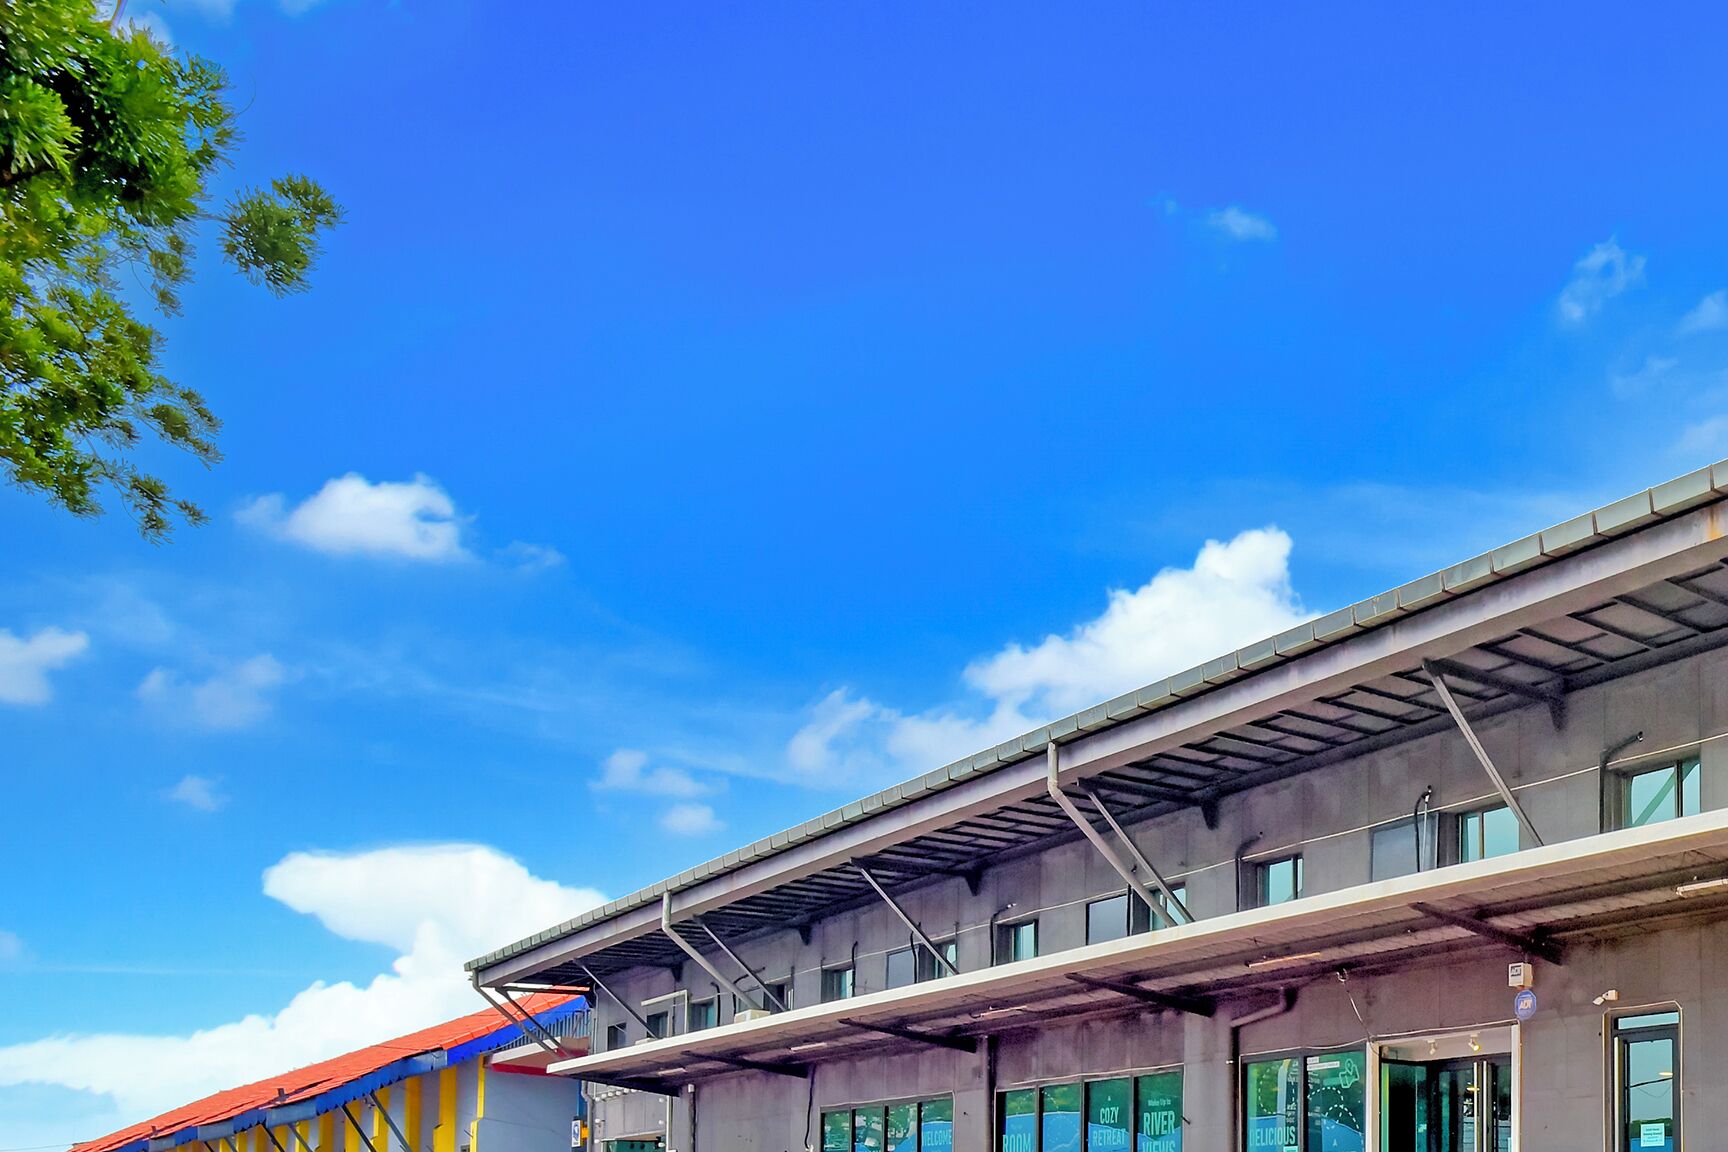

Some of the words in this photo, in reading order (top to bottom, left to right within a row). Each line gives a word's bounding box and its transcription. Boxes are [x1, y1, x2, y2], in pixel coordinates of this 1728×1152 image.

[1100, 1106, 1119, 1124] COZY
[1143, 1111, 1175, 1135] RIVER
[922, 1129, 952, 1146] WELCOME
[1093, 1128, 1126, 1146] RETREAT
[1249, 1126, 1296, 1146] DELICIOUS
